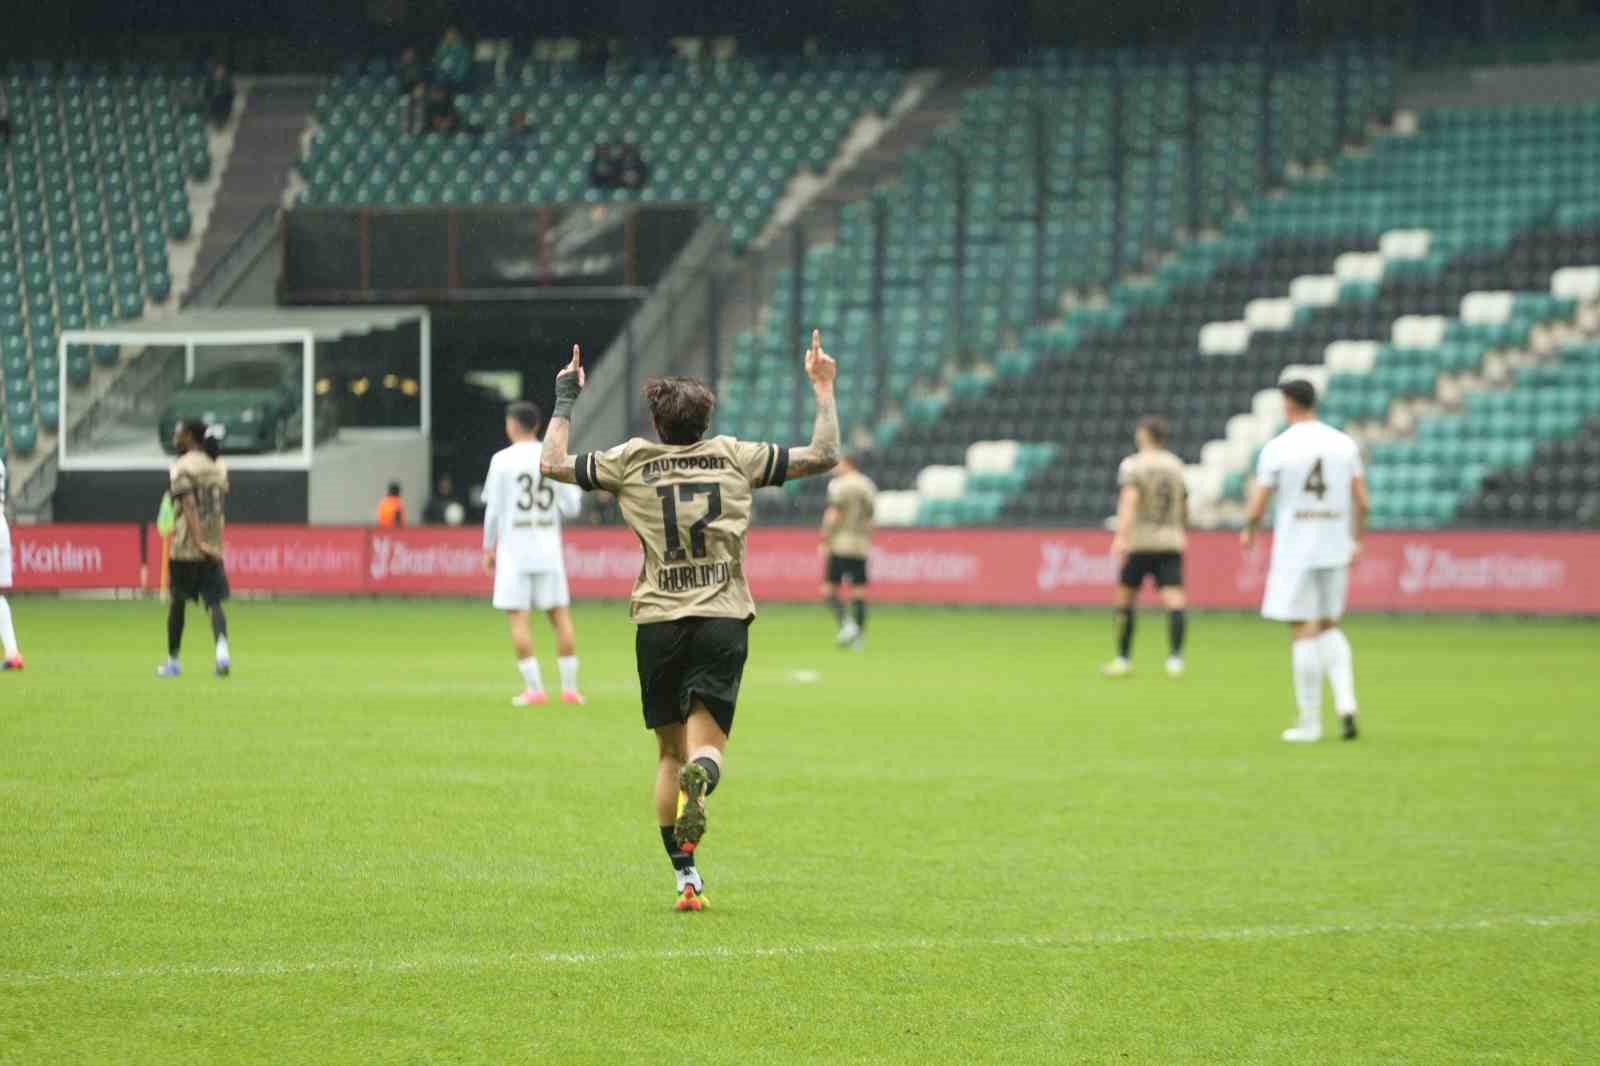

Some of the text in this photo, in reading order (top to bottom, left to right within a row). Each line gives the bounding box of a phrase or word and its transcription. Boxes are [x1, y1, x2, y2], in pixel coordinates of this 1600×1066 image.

[651, 456, 727, 473] AUTOPORT
[1303, 457, 1328, 501] 4
[516, 472, 554, 511] 35
[656, 482, 722, 562] 17
